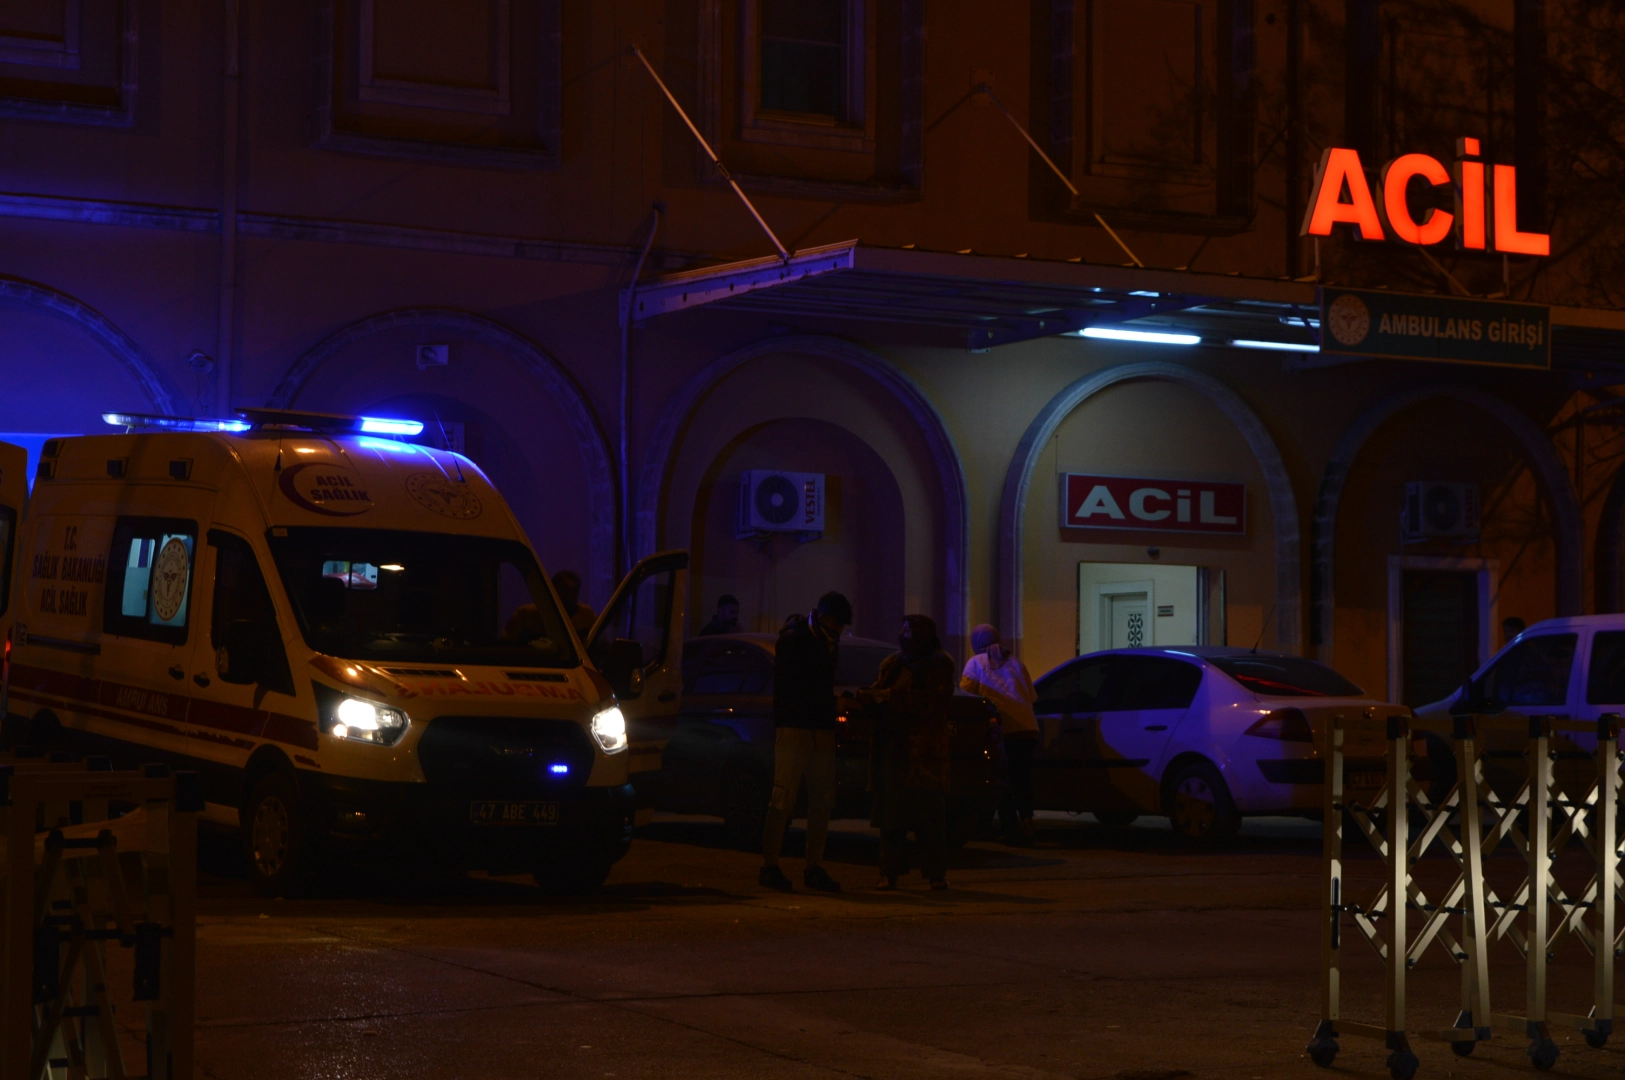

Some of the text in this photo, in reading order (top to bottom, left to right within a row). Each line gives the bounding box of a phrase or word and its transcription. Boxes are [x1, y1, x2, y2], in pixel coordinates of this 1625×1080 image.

[1307, 136, 1551, 256] ACİL
[1378, 312, 1544, 350] AMBULANS GİRİŞİ
[310, 487, 371, 502] SAĞLIK
[316, 474, 354, 487] ACİL
[804, 478, 815, 524] VESTEL
[32, 551, 105, 584] SAĞLIK BAKANLIĞI
[39, 586, 89, 616] ACİL SAĞLIK
[479, 803, 556, 821] 47 ABE 449
